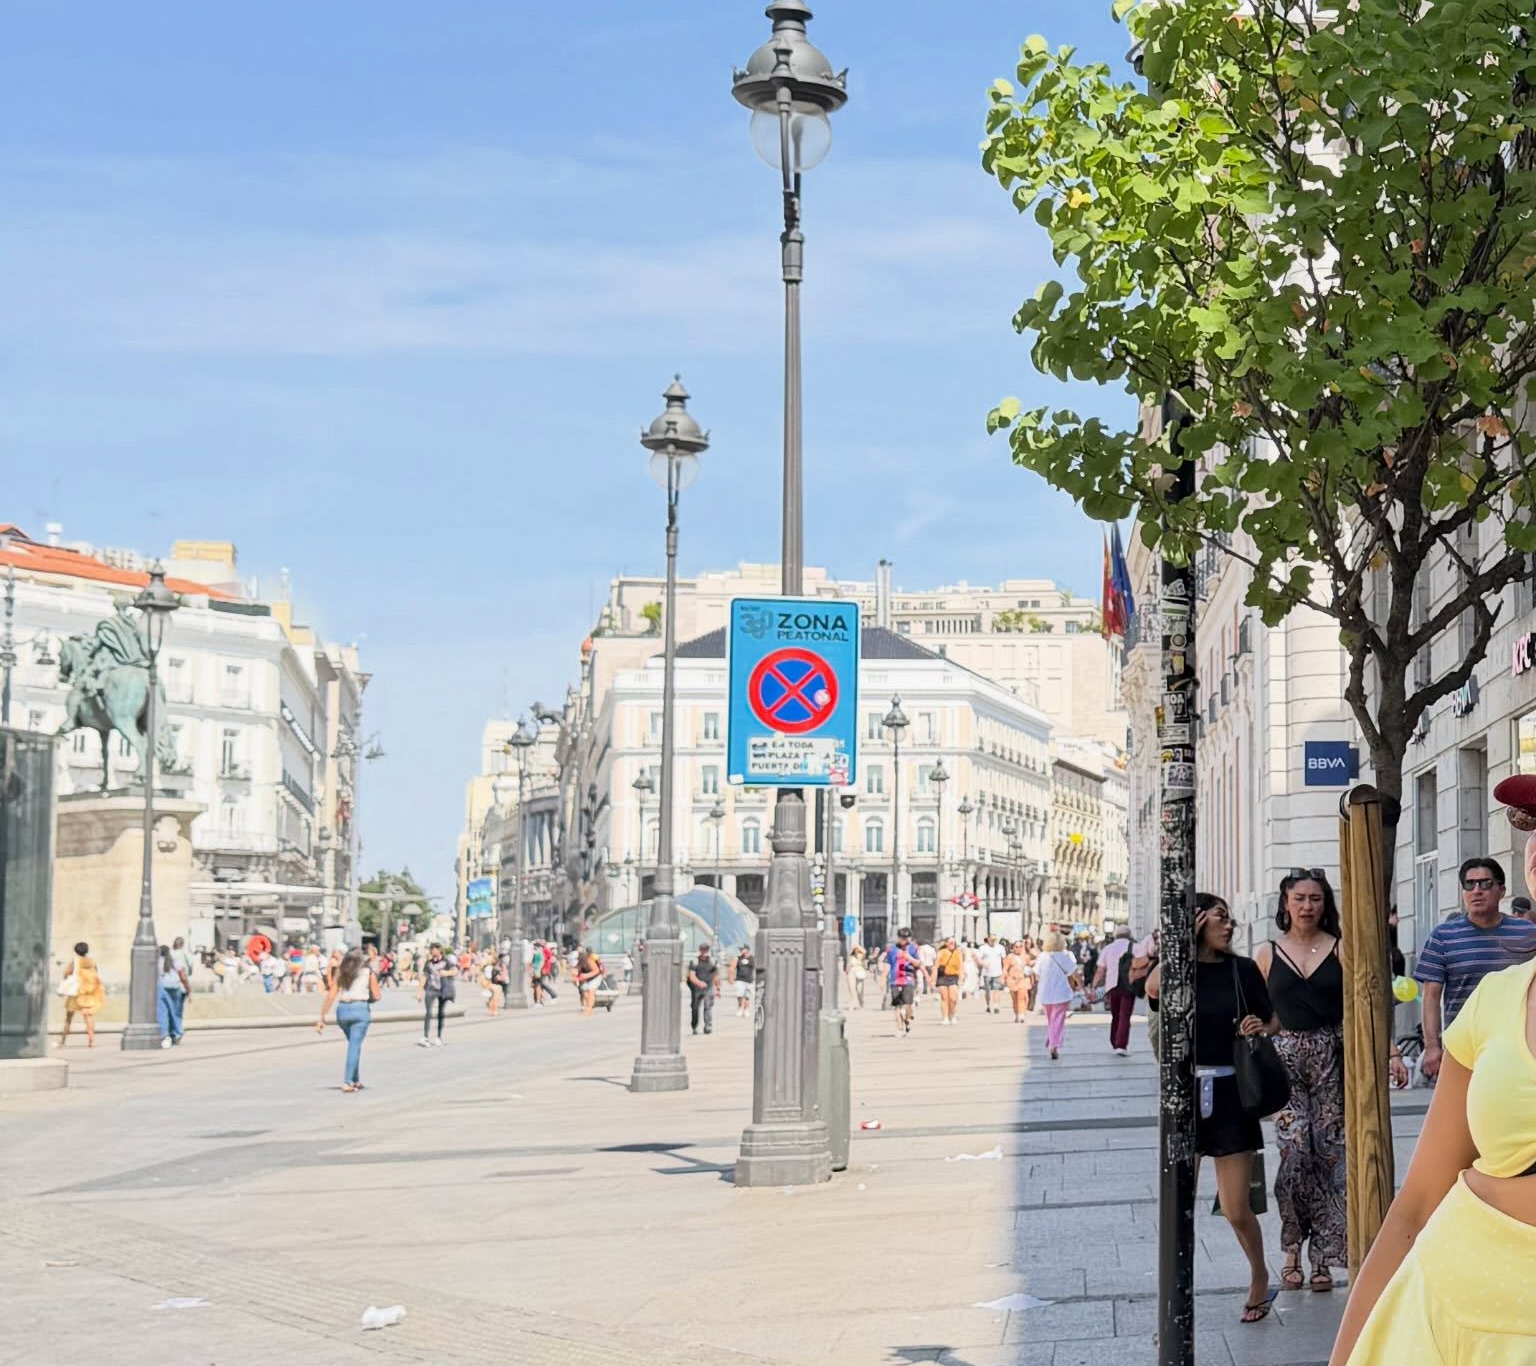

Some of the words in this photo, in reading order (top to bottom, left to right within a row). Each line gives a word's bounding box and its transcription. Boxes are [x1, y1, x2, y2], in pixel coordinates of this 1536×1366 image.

[778, 613, 848, 631] ZONA
[777, 630, 848, 642] PEATONAL
[789, 741, 814, 749] TODA
[1308, 757, 1346, 770] BBVA
